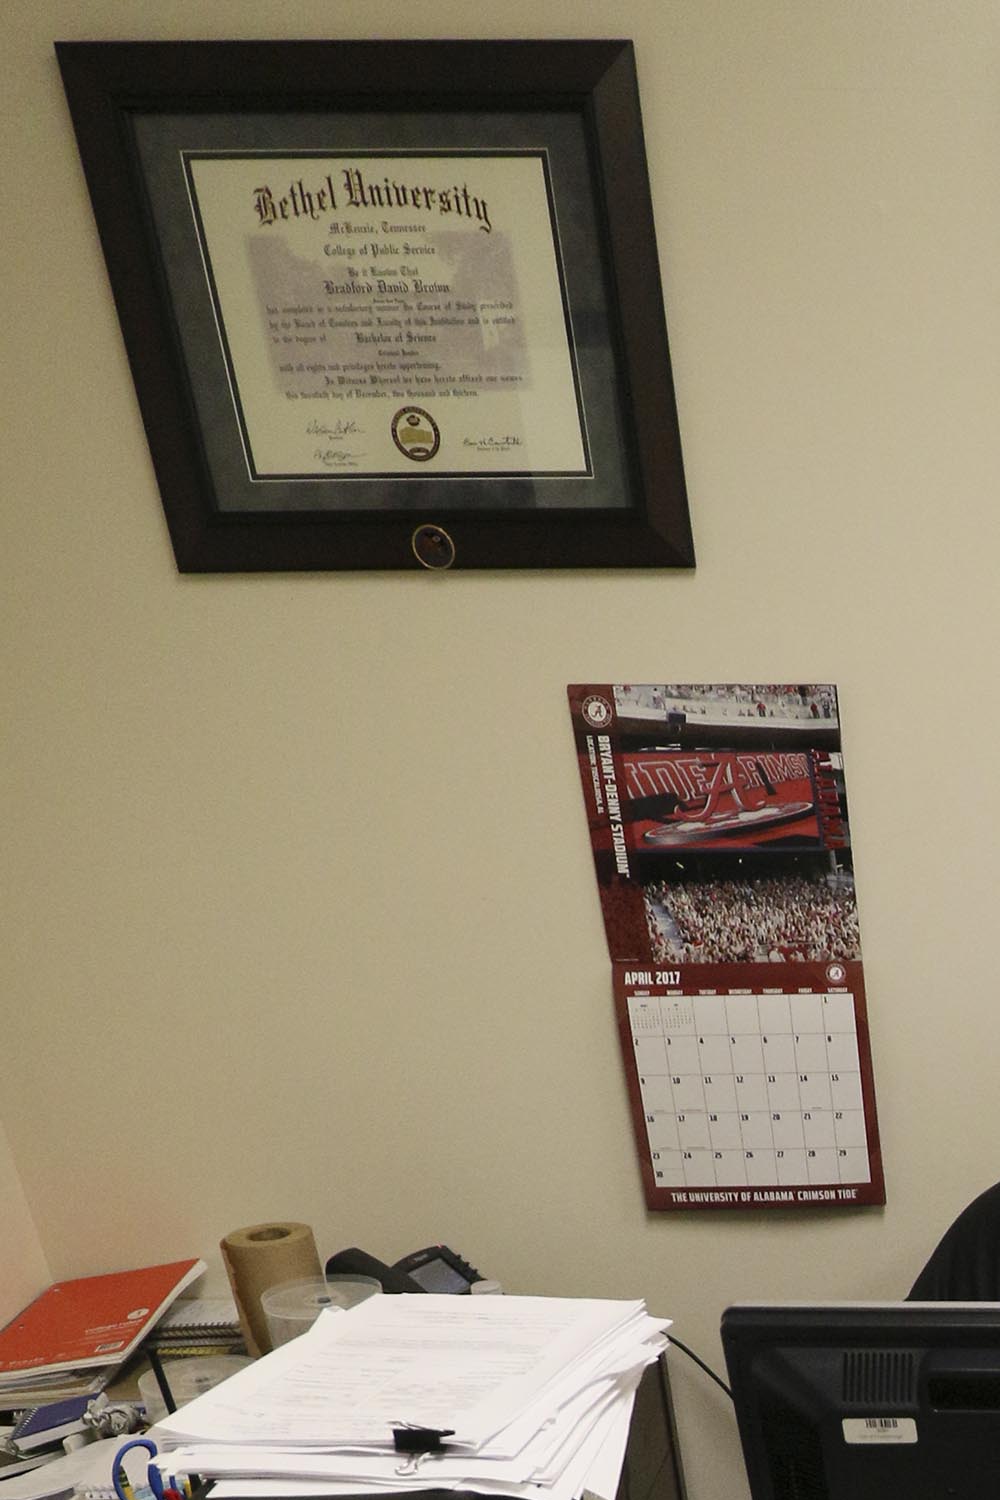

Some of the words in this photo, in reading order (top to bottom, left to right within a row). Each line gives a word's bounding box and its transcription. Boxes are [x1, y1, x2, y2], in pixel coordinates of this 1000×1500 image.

[253, 175, 337, 226] Bethel
[342, 168, 491, 234] University
[323, 279, 373, 295] Bradford
[376, 279, 409, 295] David
[412, 279, 451, 295] Brown
[597, 735, 622, 822] BRYANT-DENNY
[624, 971, 653, 986] APRIL
[655, 970, 681, 985] 2017
[672, 1077, 681, 1085] 10
[704, 1076, 712, 1084] 11
[736, 1076, 744, 1084] 12
[768, 1075, 776, 1083] 13
[831, 1074, 839, 1082] 15
[646, 1115, 655, 1123] 16
[678, 1115, 685, 1123] 17
[709, 1114, 718, 1122] 18
[772, 1113, 781, 1121] 20
[835, 1112, 843, 1120] 22
[652, 1152, 661, 1160] 23
[683, 1151, 692, 1160] 24
[714, 1151, 723, 1159] 25
[745, 1151, 754, 1159] 26
[777, 1150, 784, 1158] 27
[808, 1150, 816, 1158] 28
[839, 1149, 847, 1157] 29
[671, 1192, 688, 1203] THE
[689, 1191, 739, 1202] UNIVERSITY
[741, 1191, 752, 1201] OF
[797, 1190, 836, 1201] CRIMSON
[838, 1189, 858, 1200] TIDE
